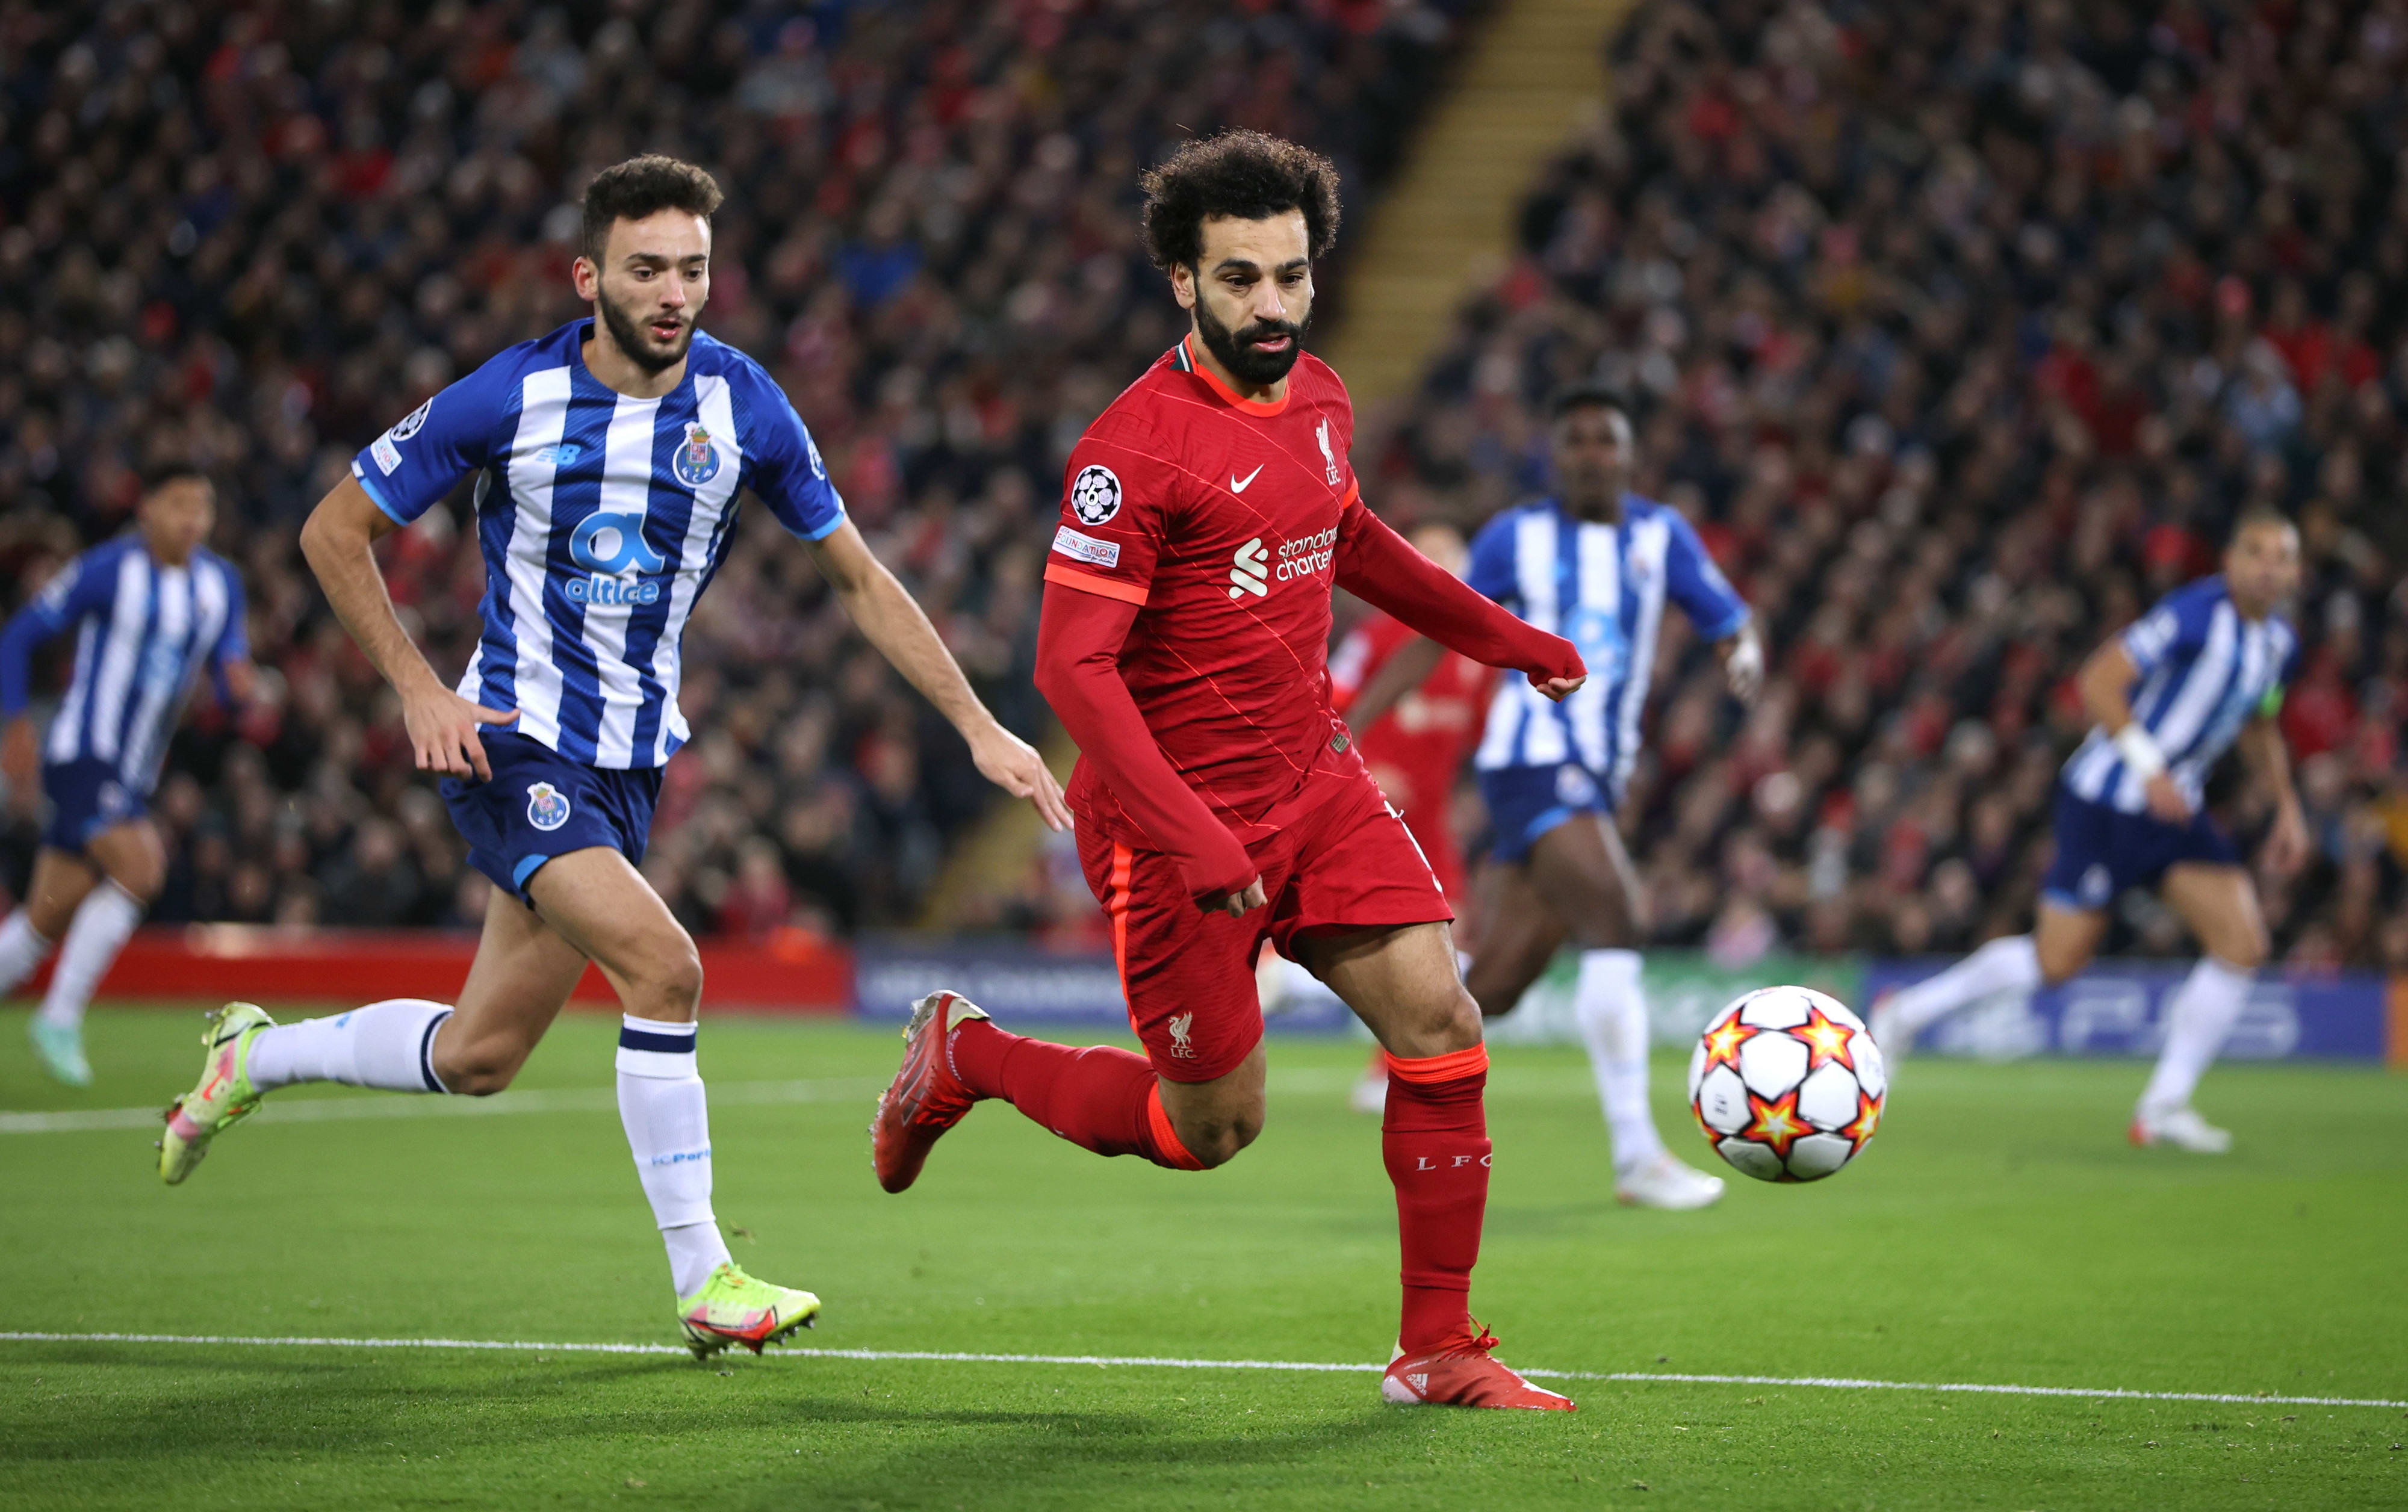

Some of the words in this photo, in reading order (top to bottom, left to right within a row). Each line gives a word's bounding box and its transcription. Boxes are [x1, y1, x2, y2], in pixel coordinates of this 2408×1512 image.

[1085, 484, 1099, 506] 6
[1057, 533, 1117, 559] FOUNDATION
[565, 576, 660, 606] altice
[1406, 1374, 1427, 1396] adidas
